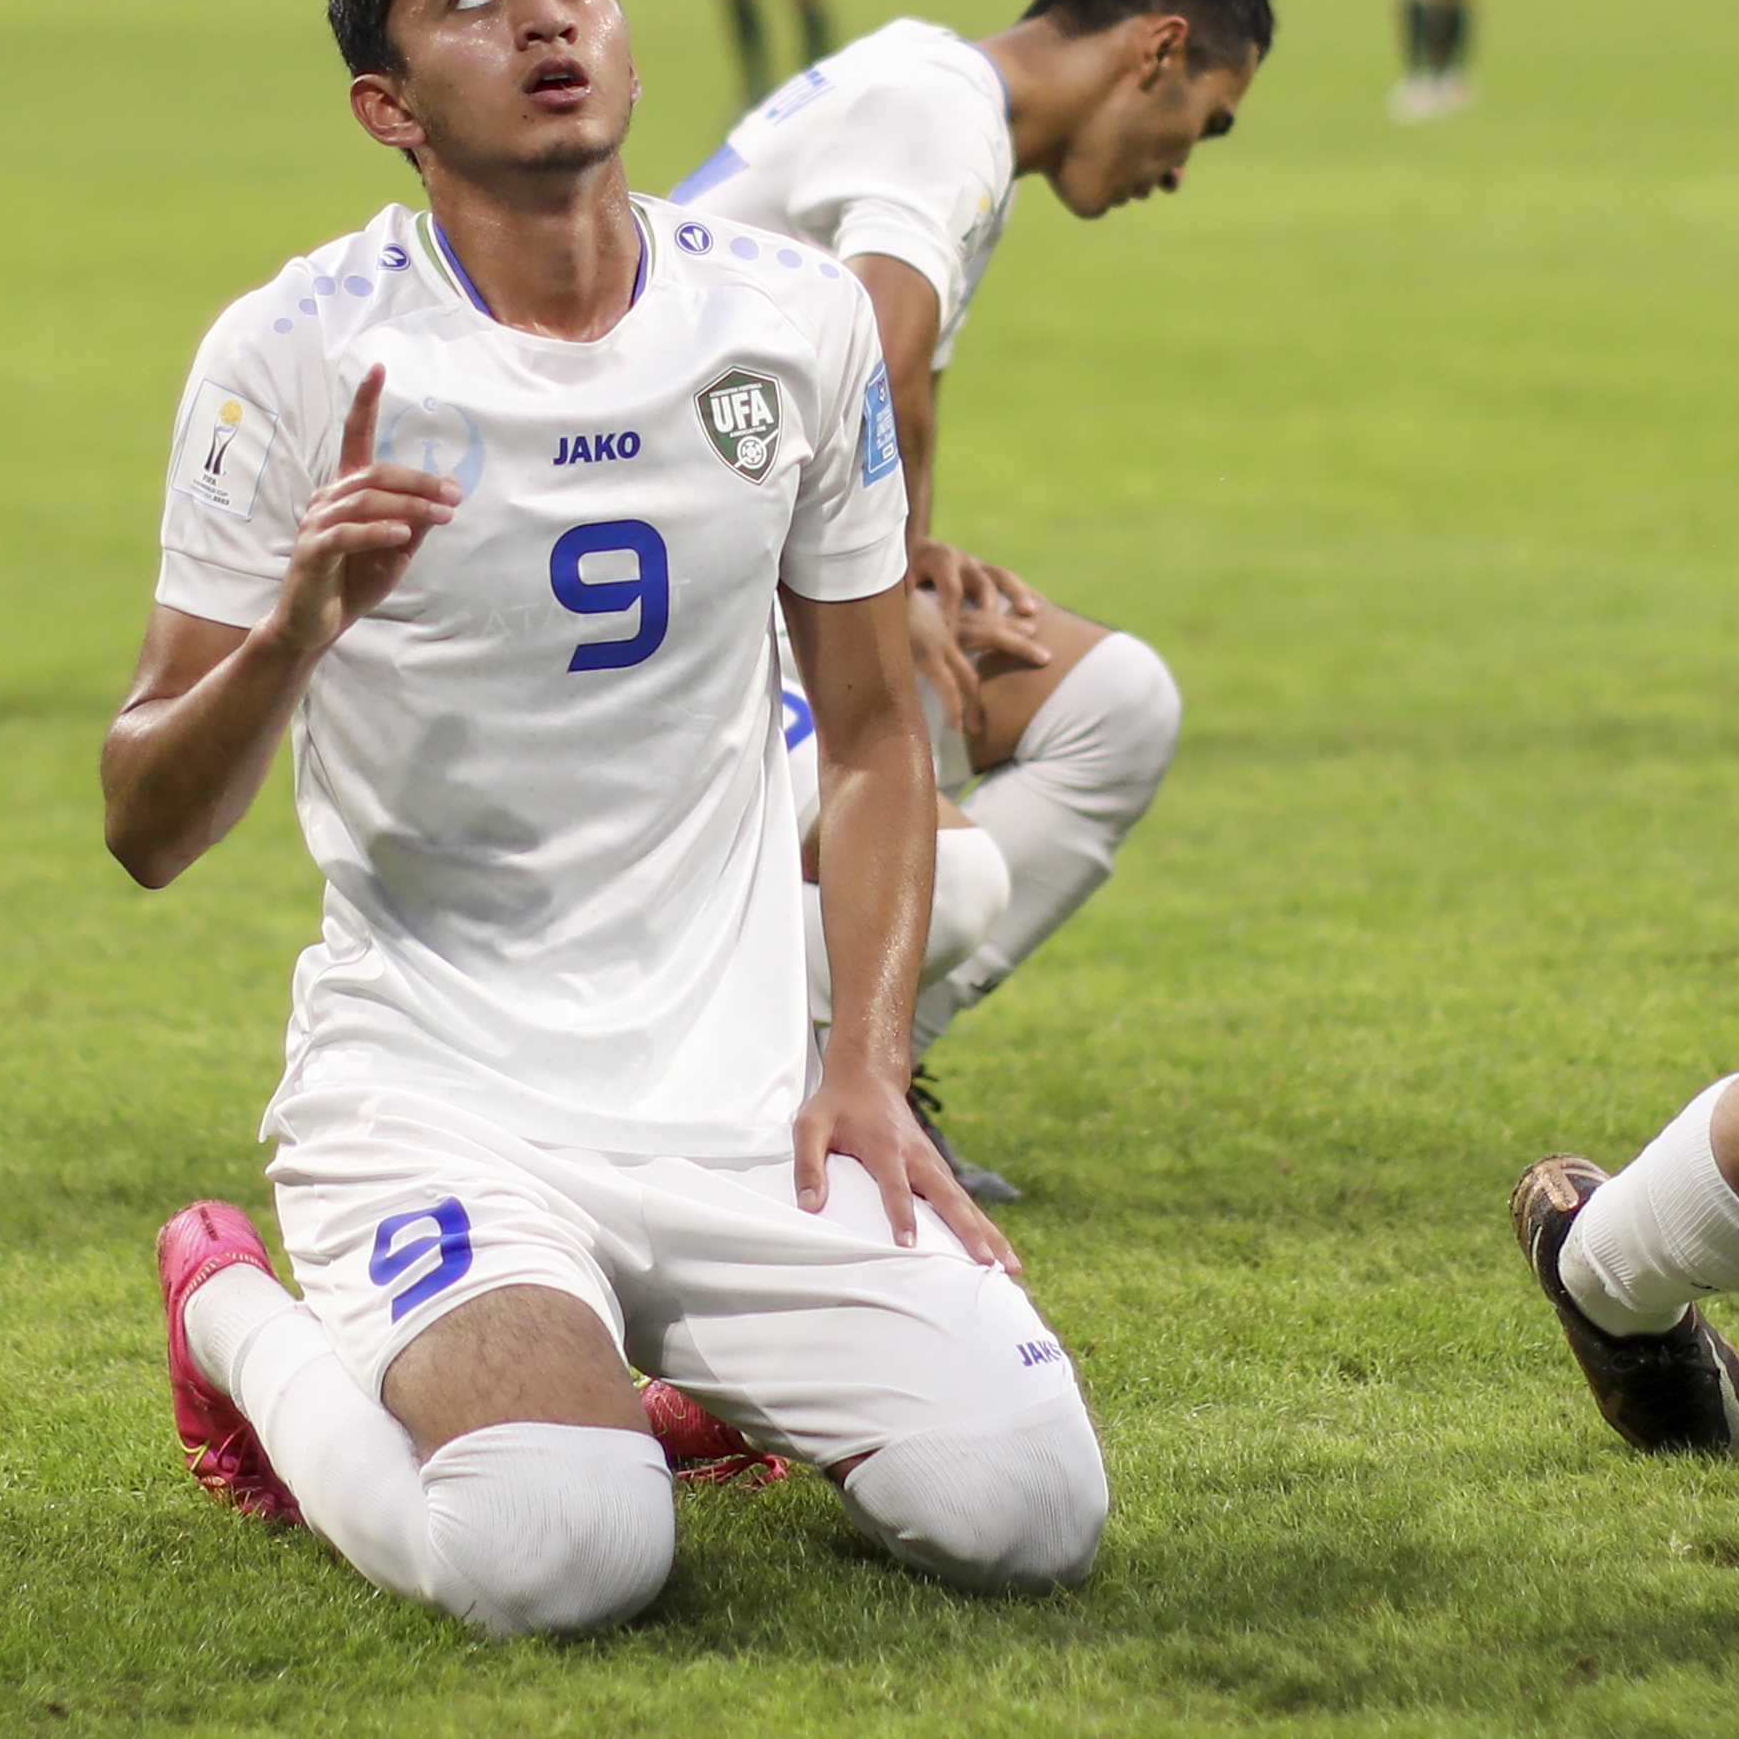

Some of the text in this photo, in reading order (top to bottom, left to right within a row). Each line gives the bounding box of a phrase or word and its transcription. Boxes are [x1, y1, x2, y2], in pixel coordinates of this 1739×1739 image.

[552, 431, 641, 466] JAKO
[710, 389, 774, 433] UFA
[549, 518, 669, 673] 9
[369, 1195, 473, 1326] 9
